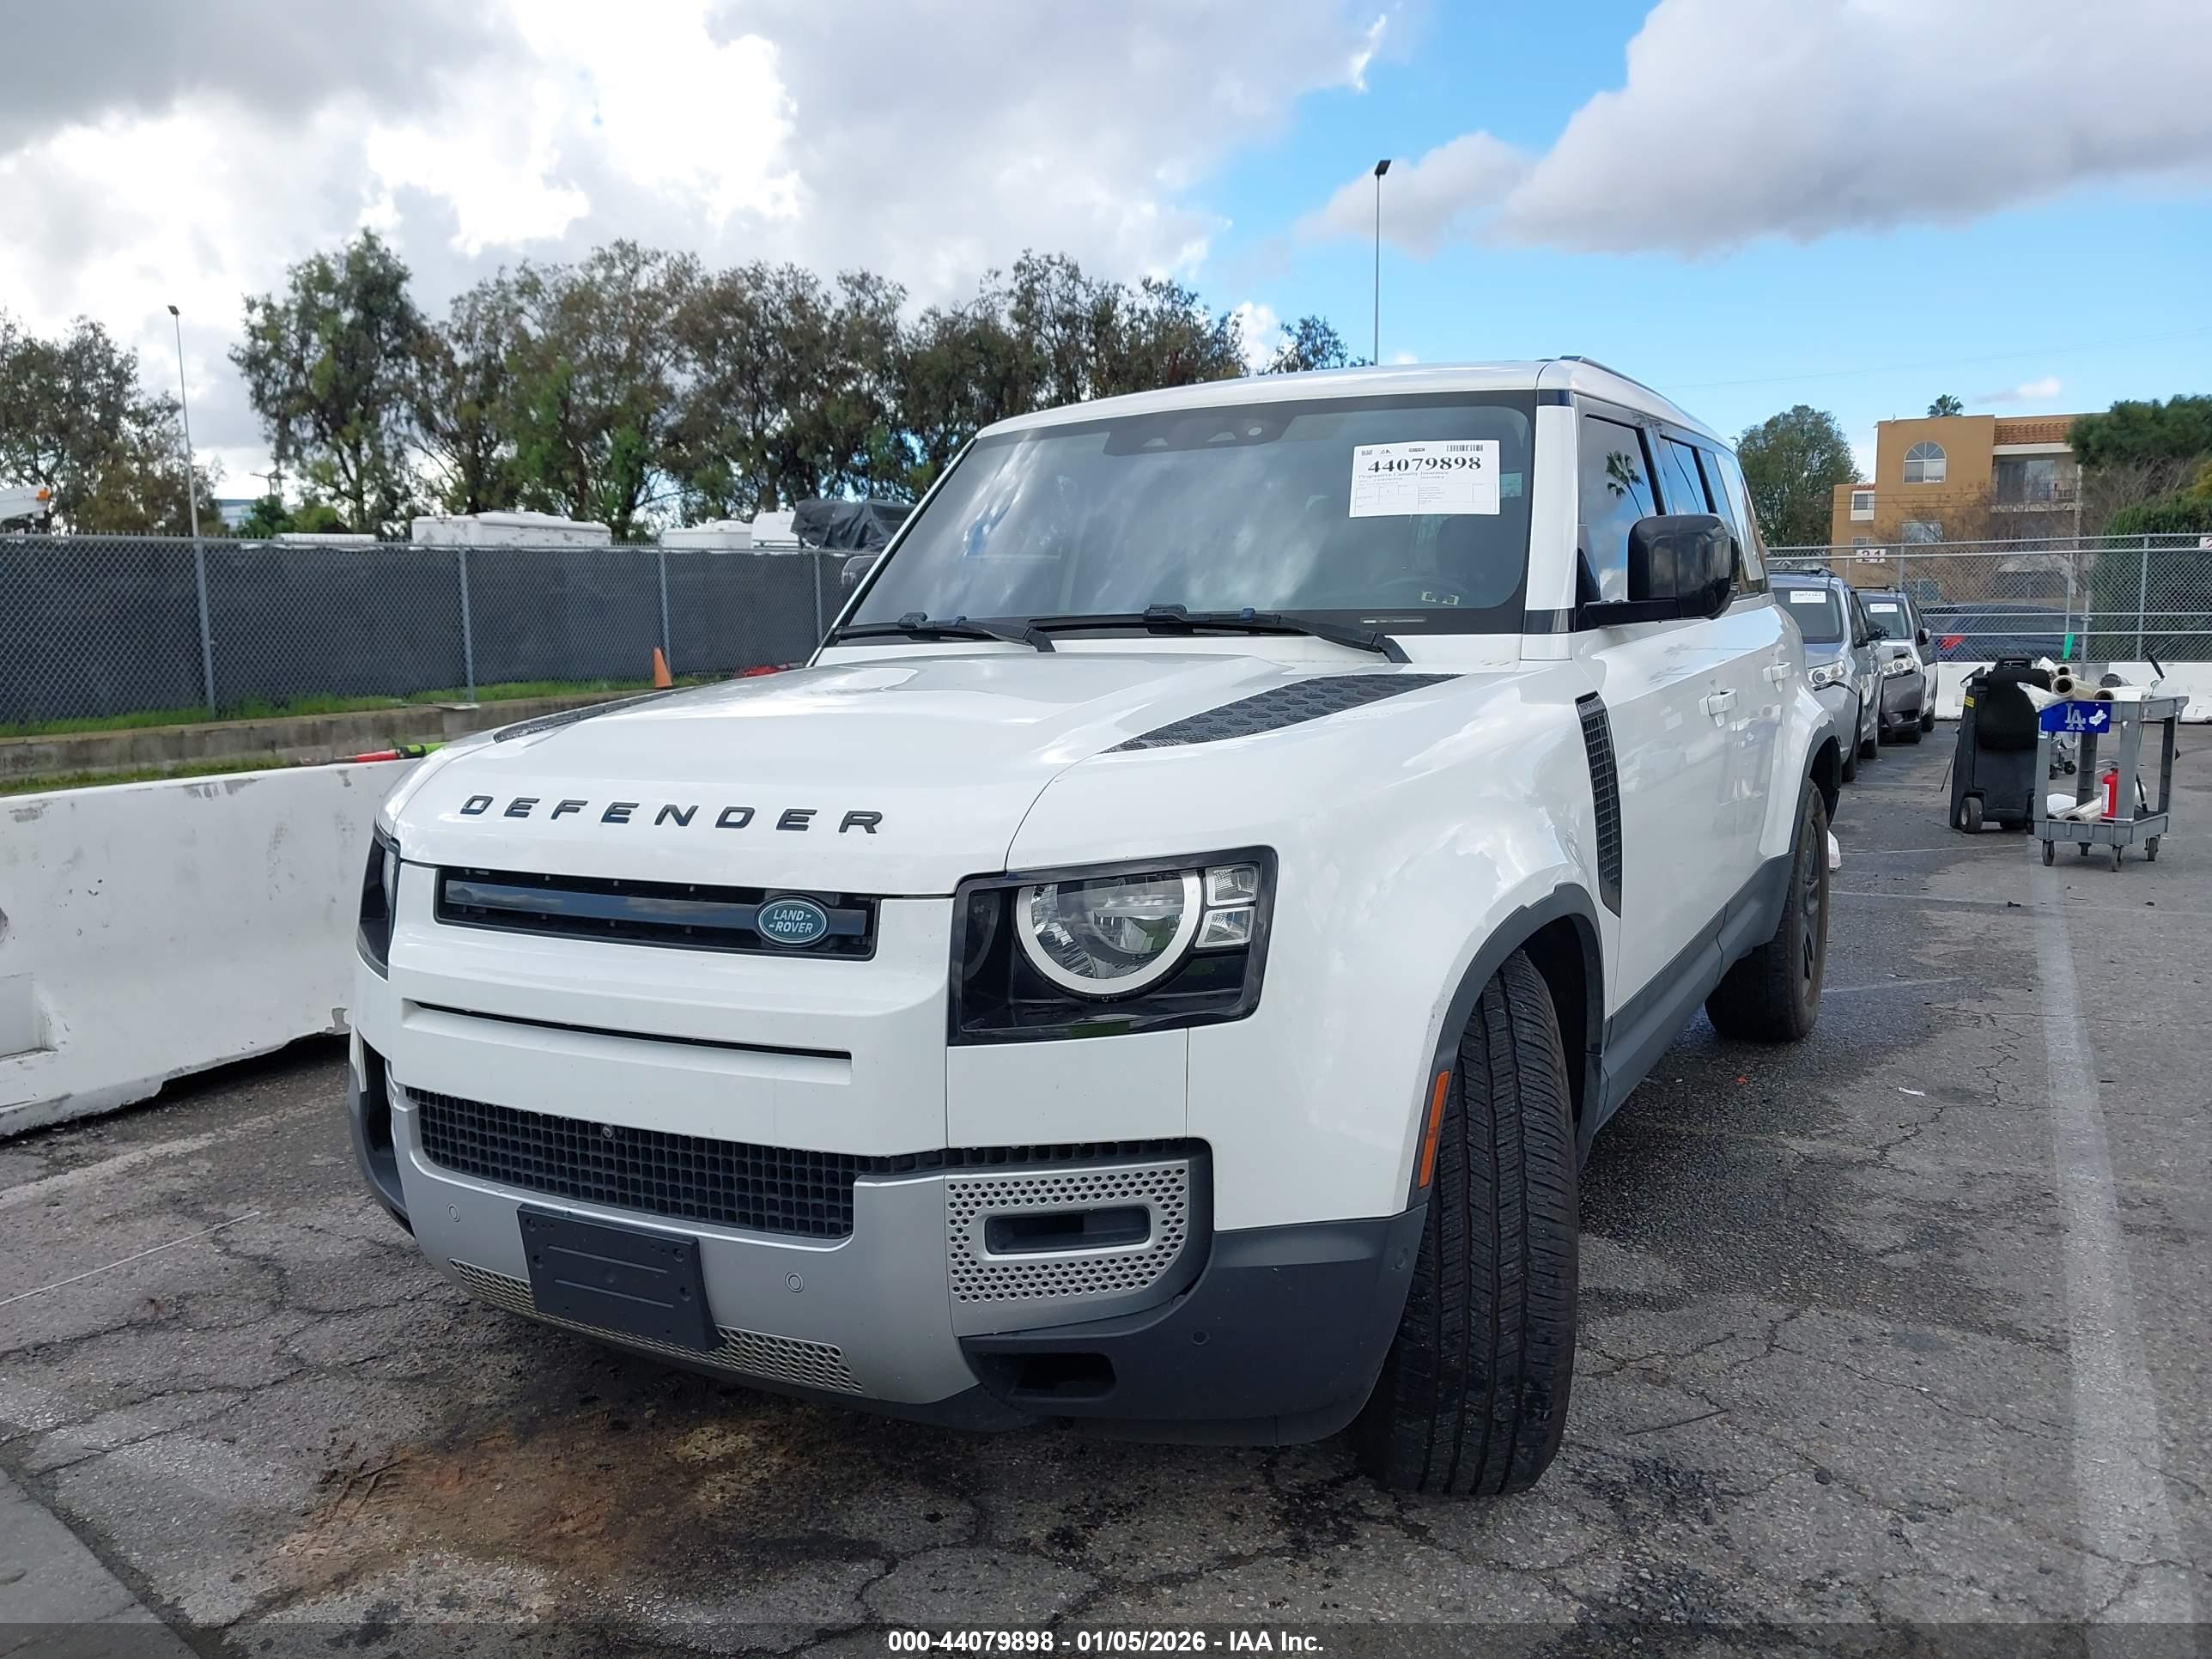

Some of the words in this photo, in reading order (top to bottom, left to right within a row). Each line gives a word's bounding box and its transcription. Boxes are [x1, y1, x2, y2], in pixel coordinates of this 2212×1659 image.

[1368, 456, 1481, 473] 44079898
[2064, 702, 2086, 730] LA
[459, 795, 883, 834] DEFENDER
